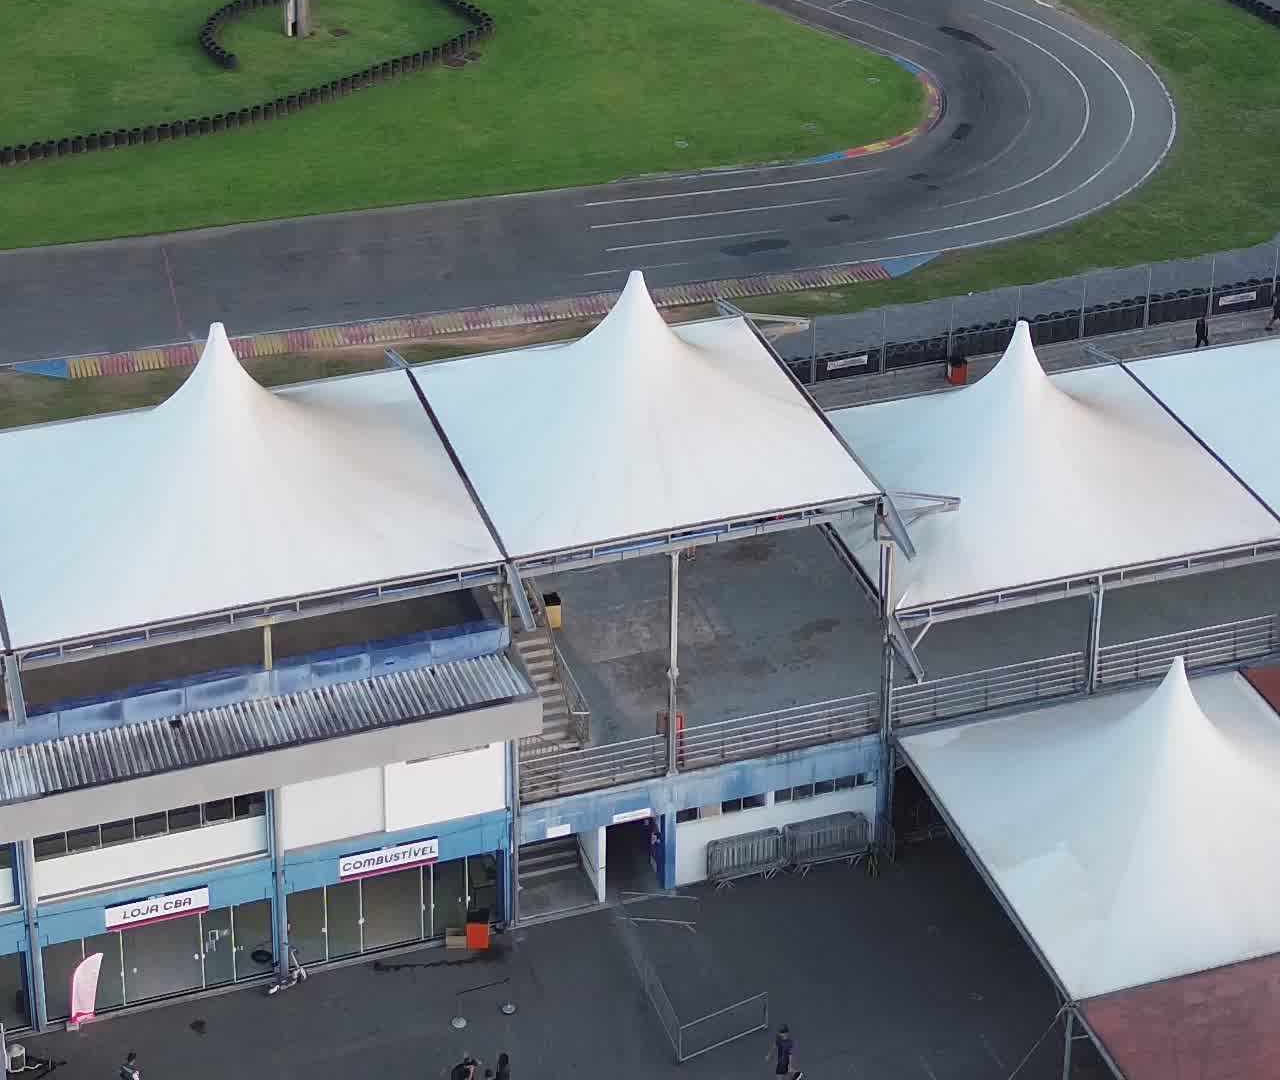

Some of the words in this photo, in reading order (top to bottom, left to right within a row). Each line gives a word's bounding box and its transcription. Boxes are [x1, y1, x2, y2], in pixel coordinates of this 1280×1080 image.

[342, 846, 435, 872] COMBUSTÍVEL
[122, 904, 159, 920] LOJA
[163, 897, 192, 911] CBA
